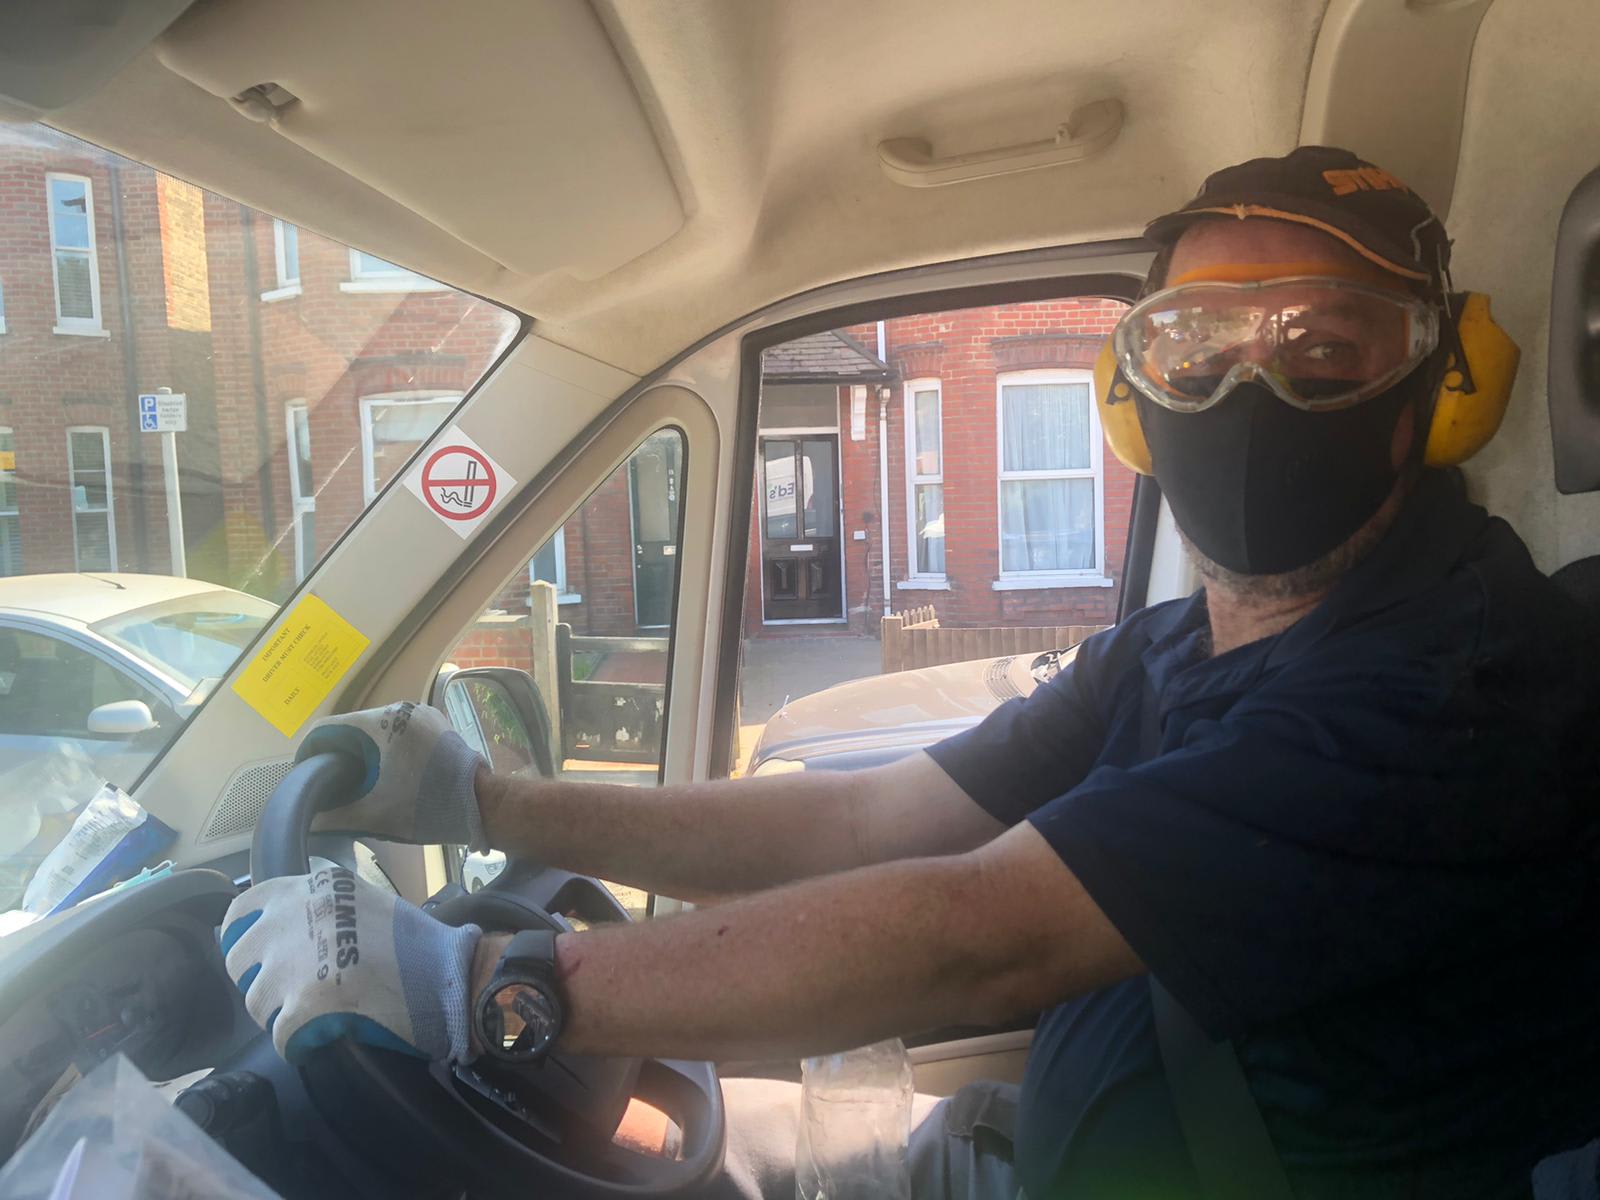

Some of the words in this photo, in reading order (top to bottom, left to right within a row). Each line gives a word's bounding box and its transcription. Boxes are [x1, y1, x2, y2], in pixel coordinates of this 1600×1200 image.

[144, 398, 154, 411] P
[262, 627, 291, 661] IMPORTANT
[262, 660, 282, 682] DRIVER
[279, 642, 295, 662] MUST
[293, 624, 311, 645] CHECK
[283, 687, 301, 706] DAILY
[317, 964, 329, 981] 9
